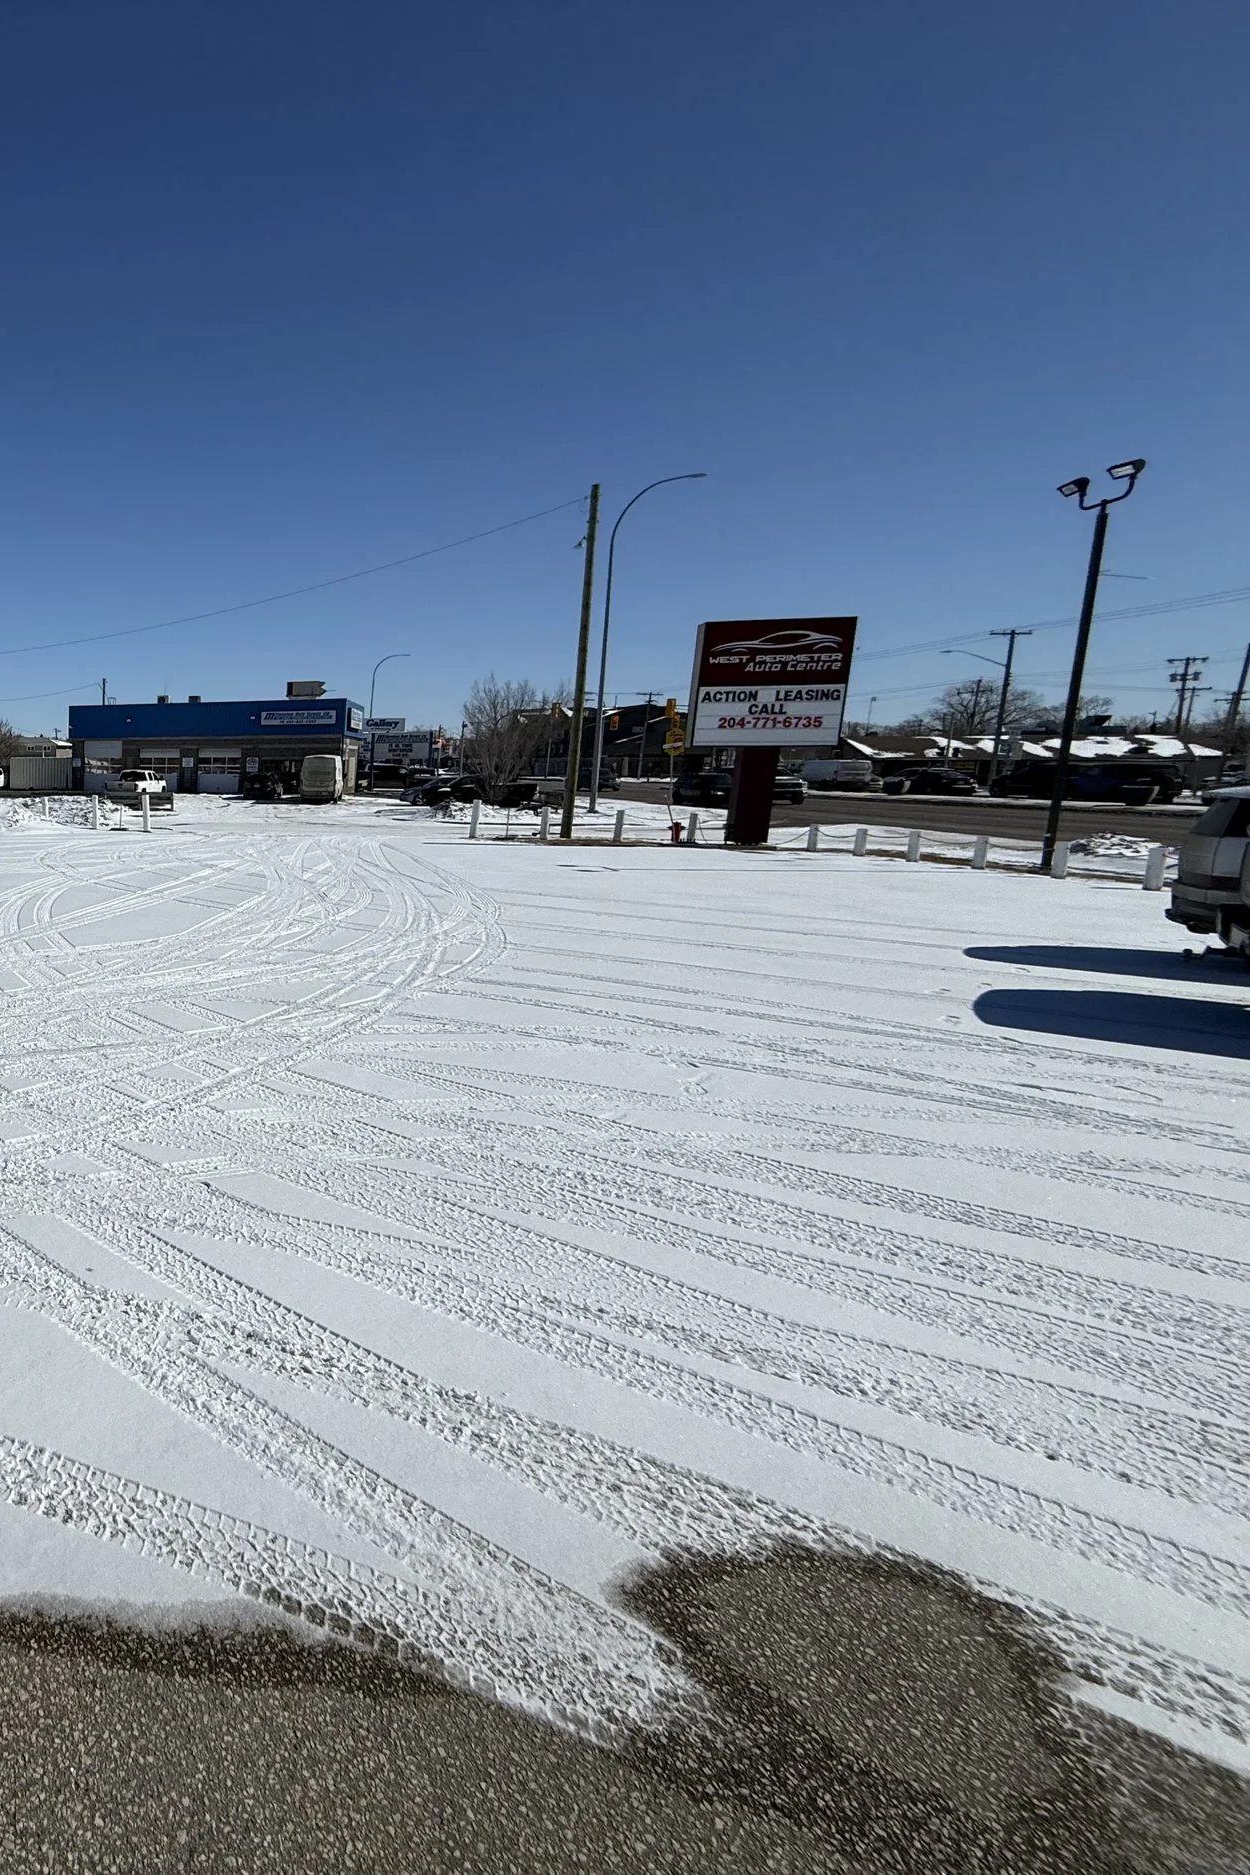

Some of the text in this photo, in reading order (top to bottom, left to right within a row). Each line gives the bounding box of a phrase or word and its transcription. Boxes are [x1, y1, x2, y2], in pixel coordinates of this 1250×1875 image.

[709, 653, 843, 664] WEST PERIMETER
[744, 662, 842, 672] Auto Centre
[701, 689, 841, 703] ACTION LEASING
[748, 704, 787, 715] CALL
[366, 719, 400, 729] Gallery
[718, 716, 823, 729] 204-771-6735
